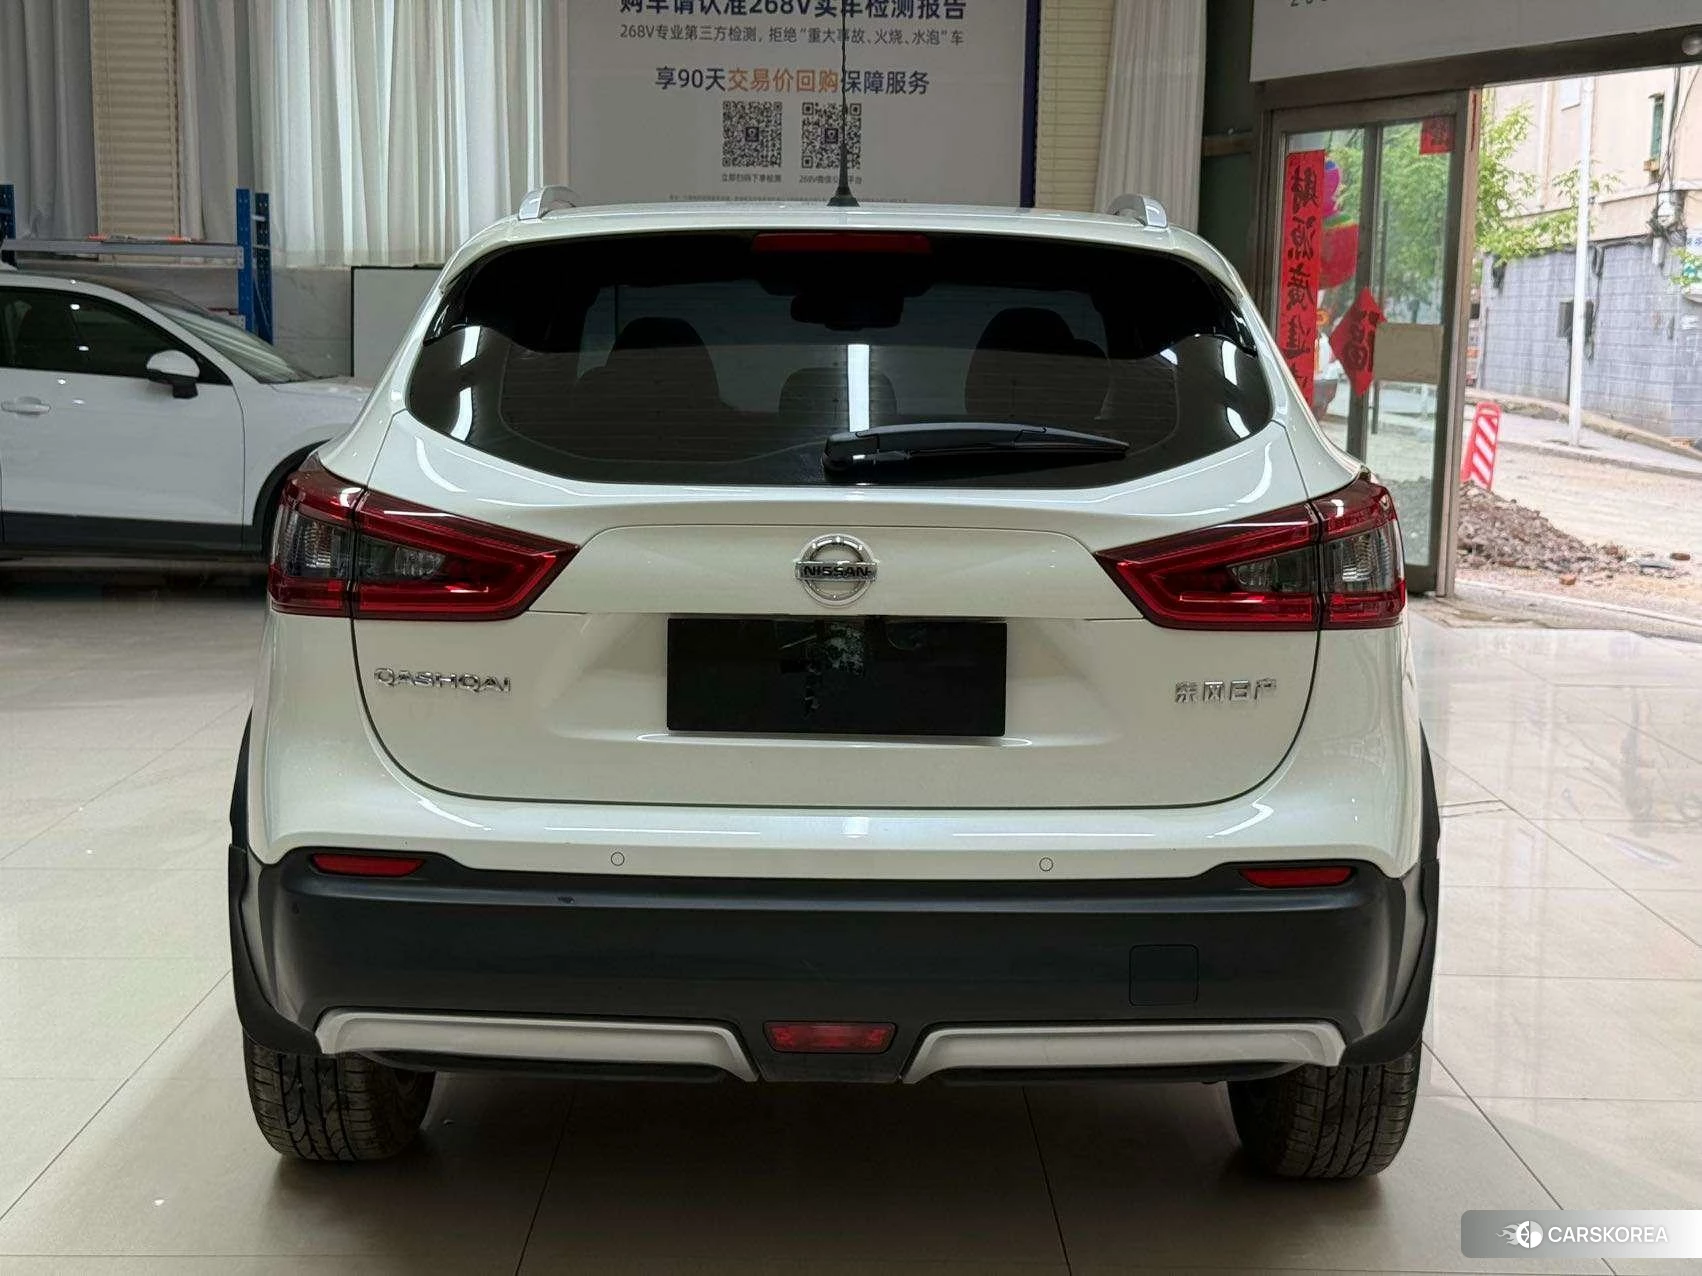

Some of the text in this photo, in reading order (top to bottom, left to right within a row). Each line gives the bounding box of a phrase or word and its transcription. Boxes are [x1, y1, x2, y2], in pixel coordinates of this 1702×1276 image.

[655, 66, 930, 95] 享90天交易价回购保障服务
[802, 564, 871, 578] NISSAN
[373, 667, 512, 694] QASHQAI
